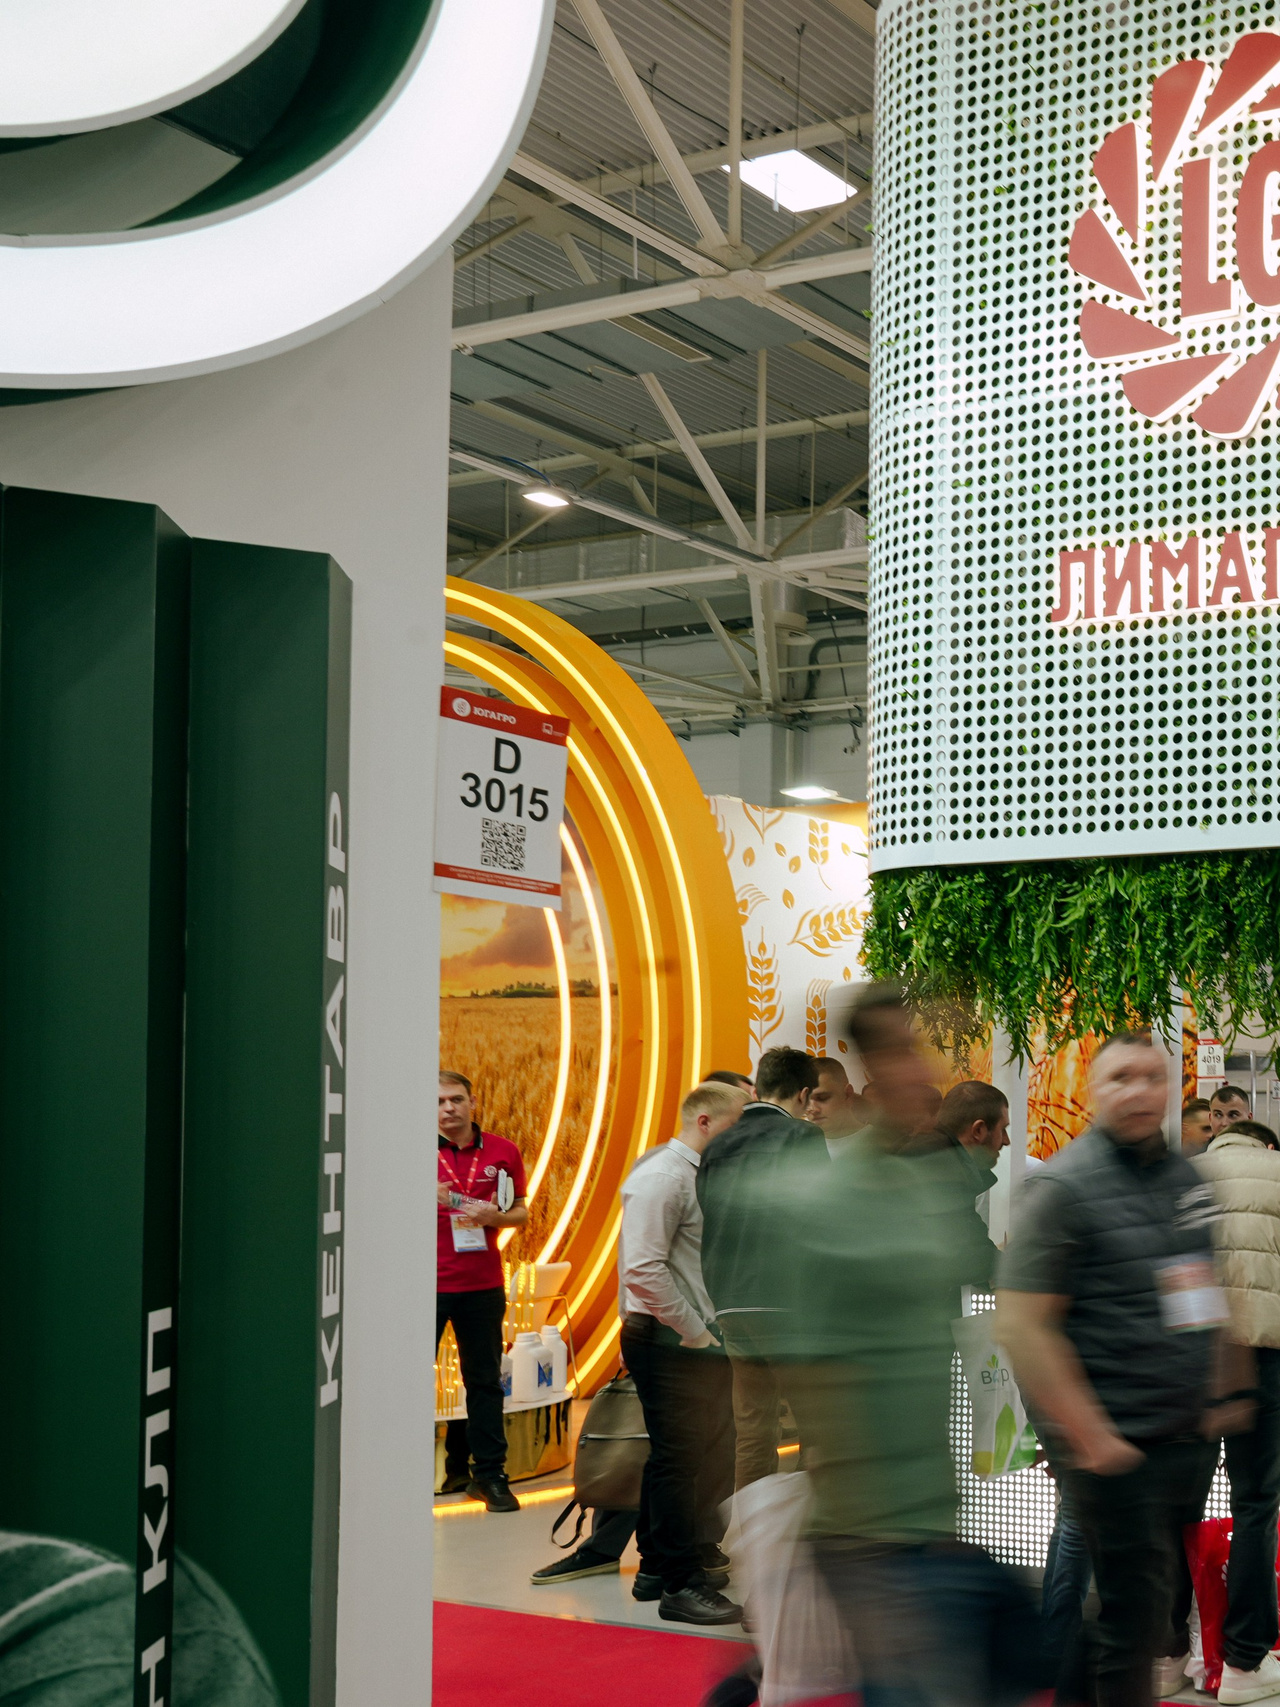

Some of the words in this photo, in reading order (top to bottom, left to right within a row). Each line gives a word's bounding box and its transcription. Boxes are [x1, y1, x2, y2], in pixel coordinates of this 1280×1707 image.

[473, 706, 517, 725] ЮГАГРО
[493, 737, 522, 774] D
[460, 772, 549, 822] 3015
[1202, 1055, 1221, 1064] 4019
[1208, 1046, 1215, 1055] D
[320, 790, 346, 1408] КЕНТАВР
[143, 1306, 172, 1595] КЛП
